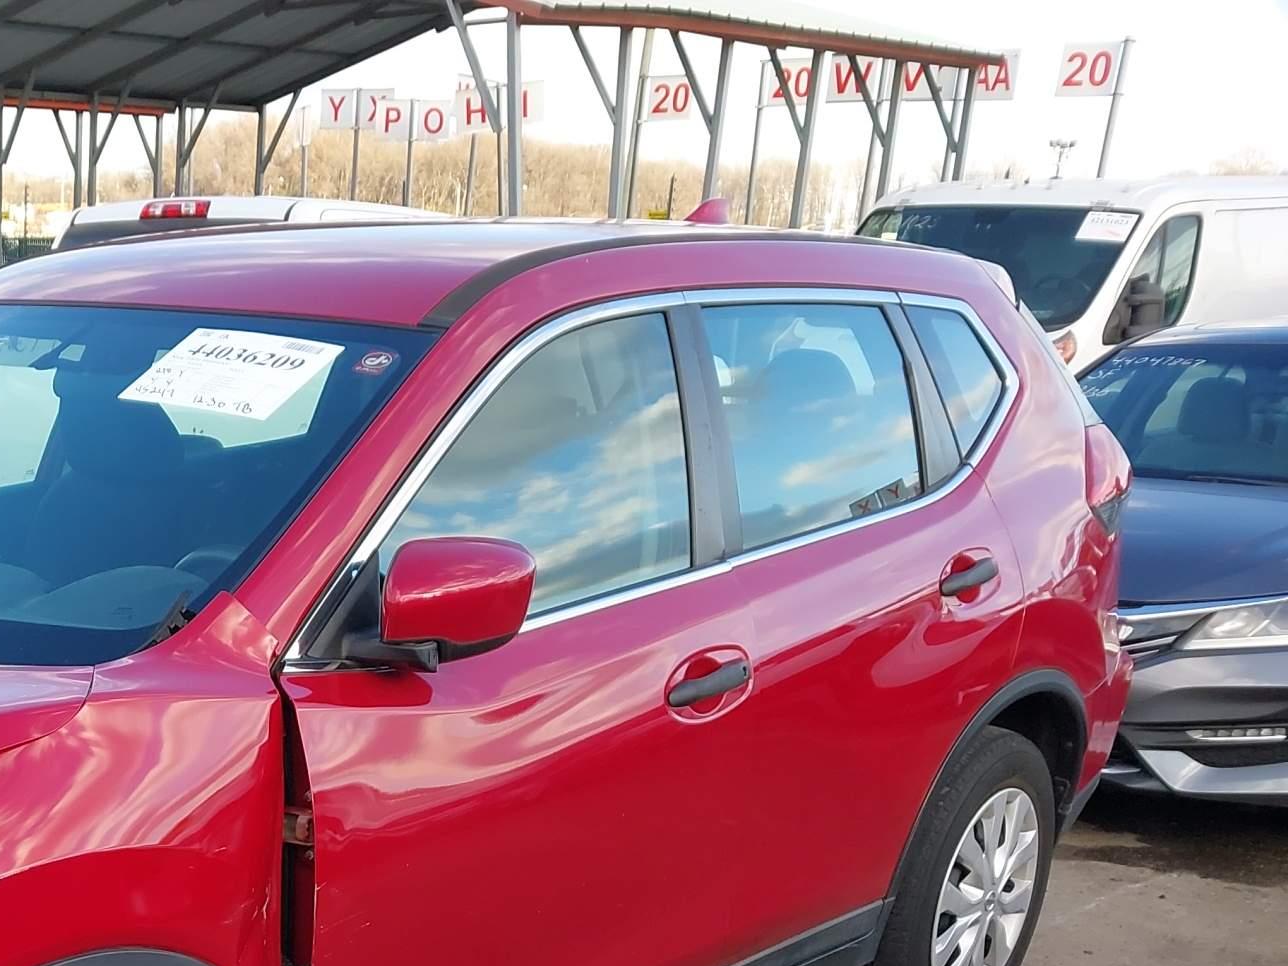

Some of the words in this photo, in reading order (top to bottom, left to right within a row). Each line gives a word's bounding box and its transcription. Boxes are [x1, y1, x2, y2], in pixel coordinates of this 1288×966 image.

[1062, 51, 1112, 86] 20
[328, 96, 345, 121] Y
[466, 97, 486, 125] H
[652, 82, 690, 113] 20
[384, 107, 401, 132] P
[424, 108, 444, 134] O
[188, 343, 306, 371] 44036209
